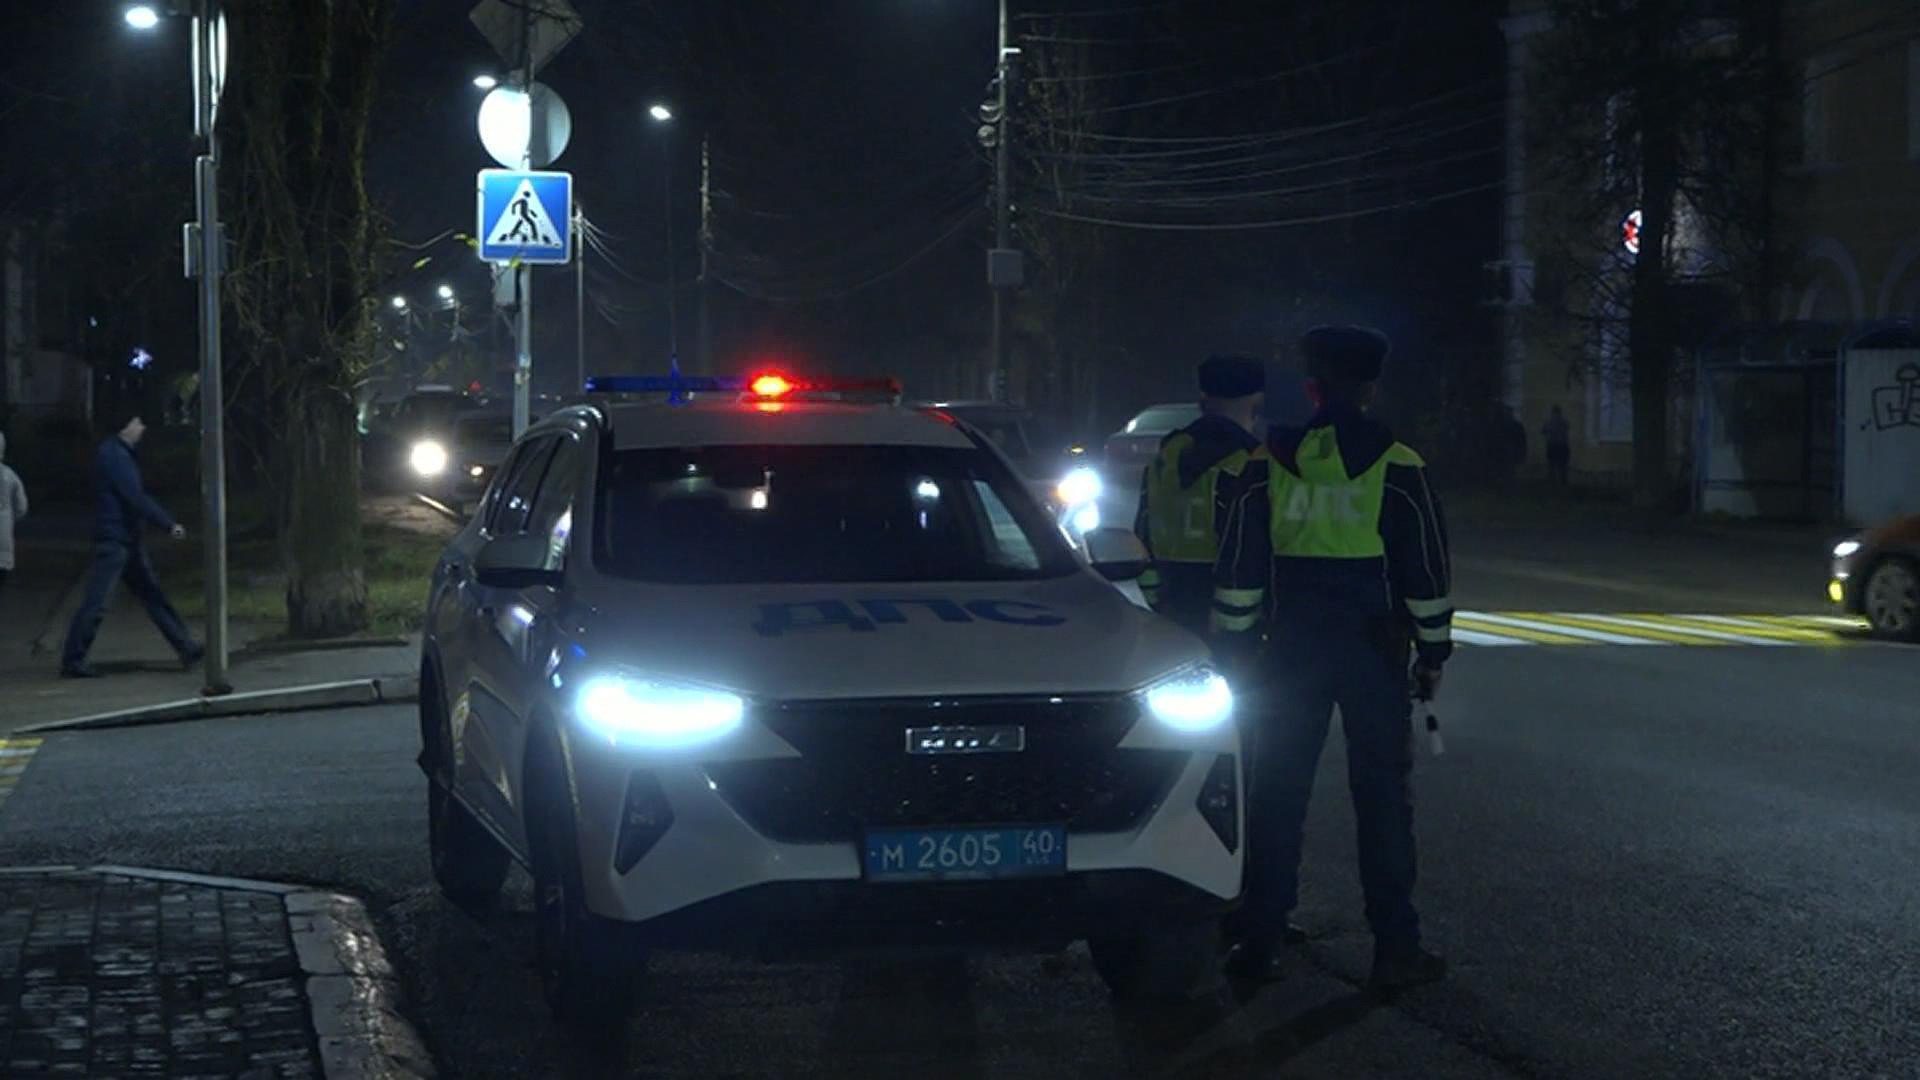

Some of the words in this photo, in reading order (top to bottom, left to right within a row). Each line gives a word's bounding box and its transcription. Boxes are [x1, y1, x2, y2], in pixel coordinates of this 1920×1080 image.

[1284, 484, 1368, 523] ДПС
[751, 599, 1068, 638] ДПС
[918, 833, 1000, 868] 2605
[1023, 831, 1054, 854] 40
